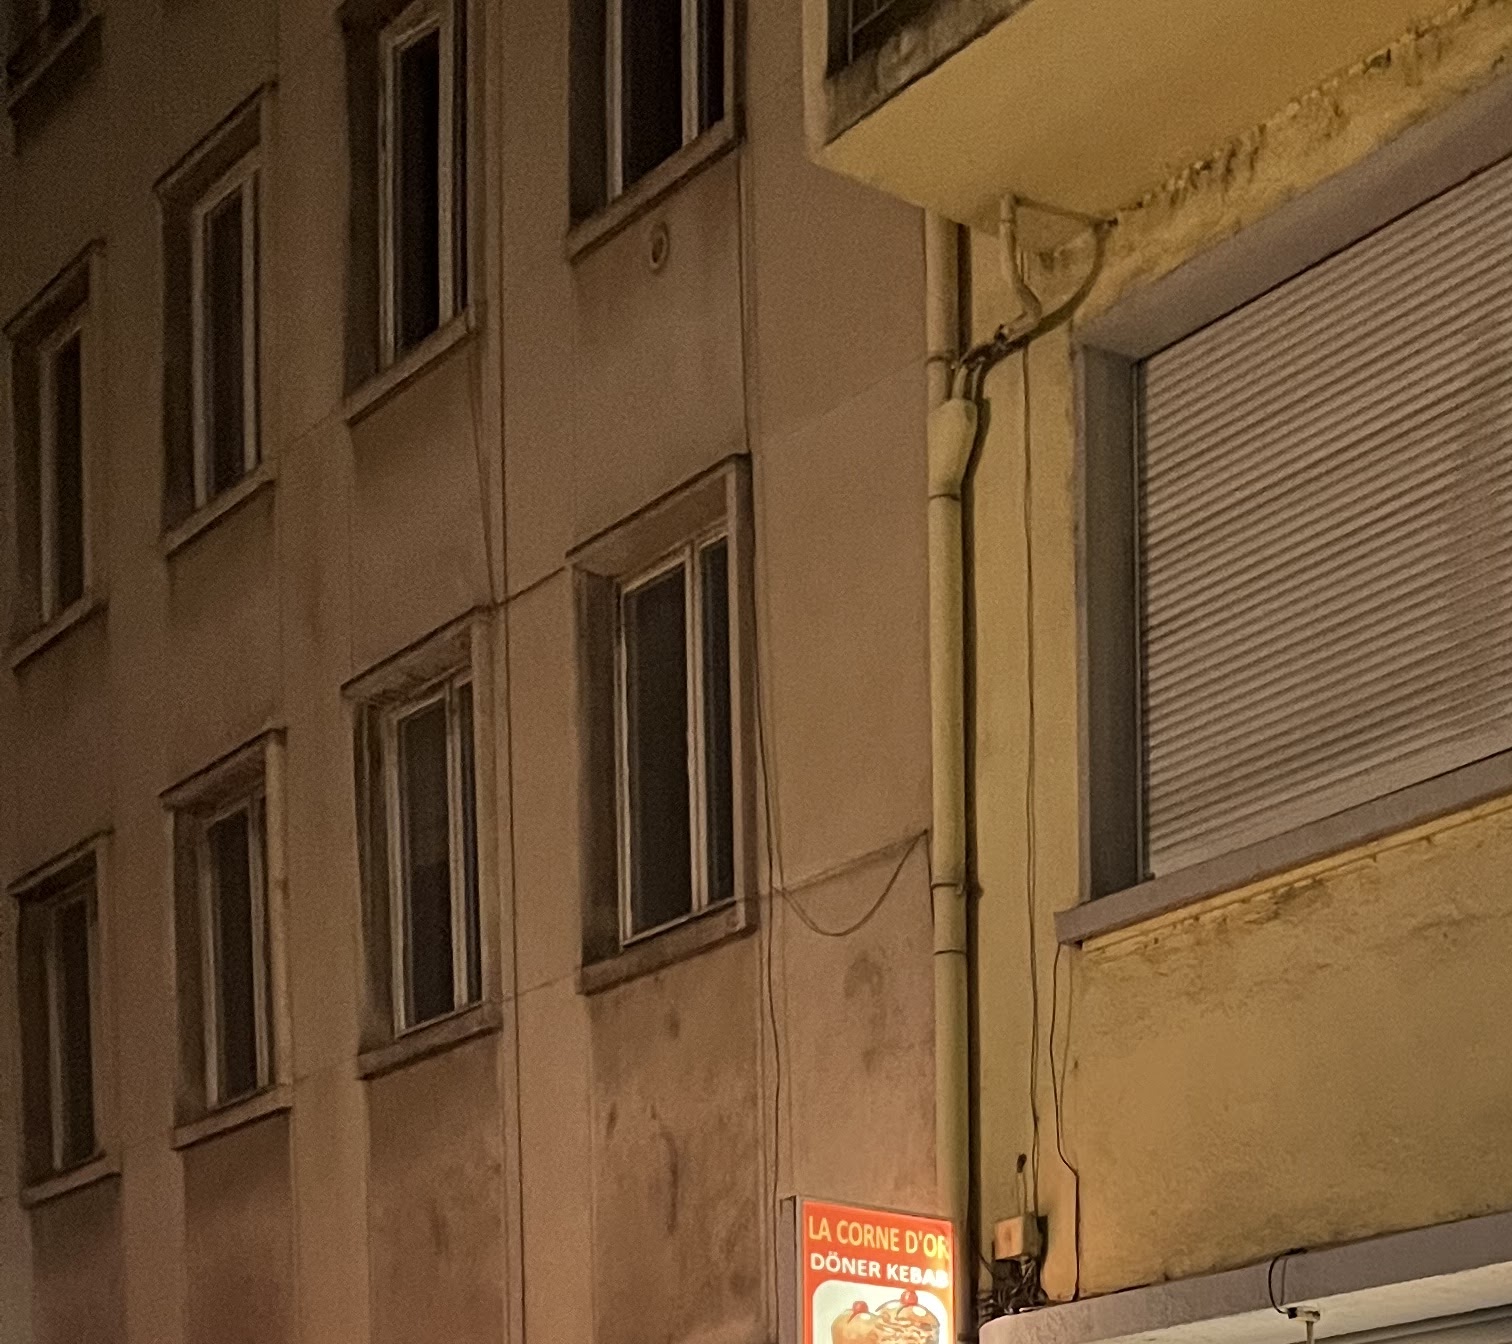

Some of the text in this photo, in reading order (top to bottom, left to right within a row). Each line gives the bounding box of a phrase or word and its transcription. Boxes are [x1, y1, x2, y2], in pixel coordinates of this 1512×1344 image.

[808, 1215, 950, 1260] LA CORNE D'OR
[810, 1250, 950, 1289] DÖNER KEBAB
